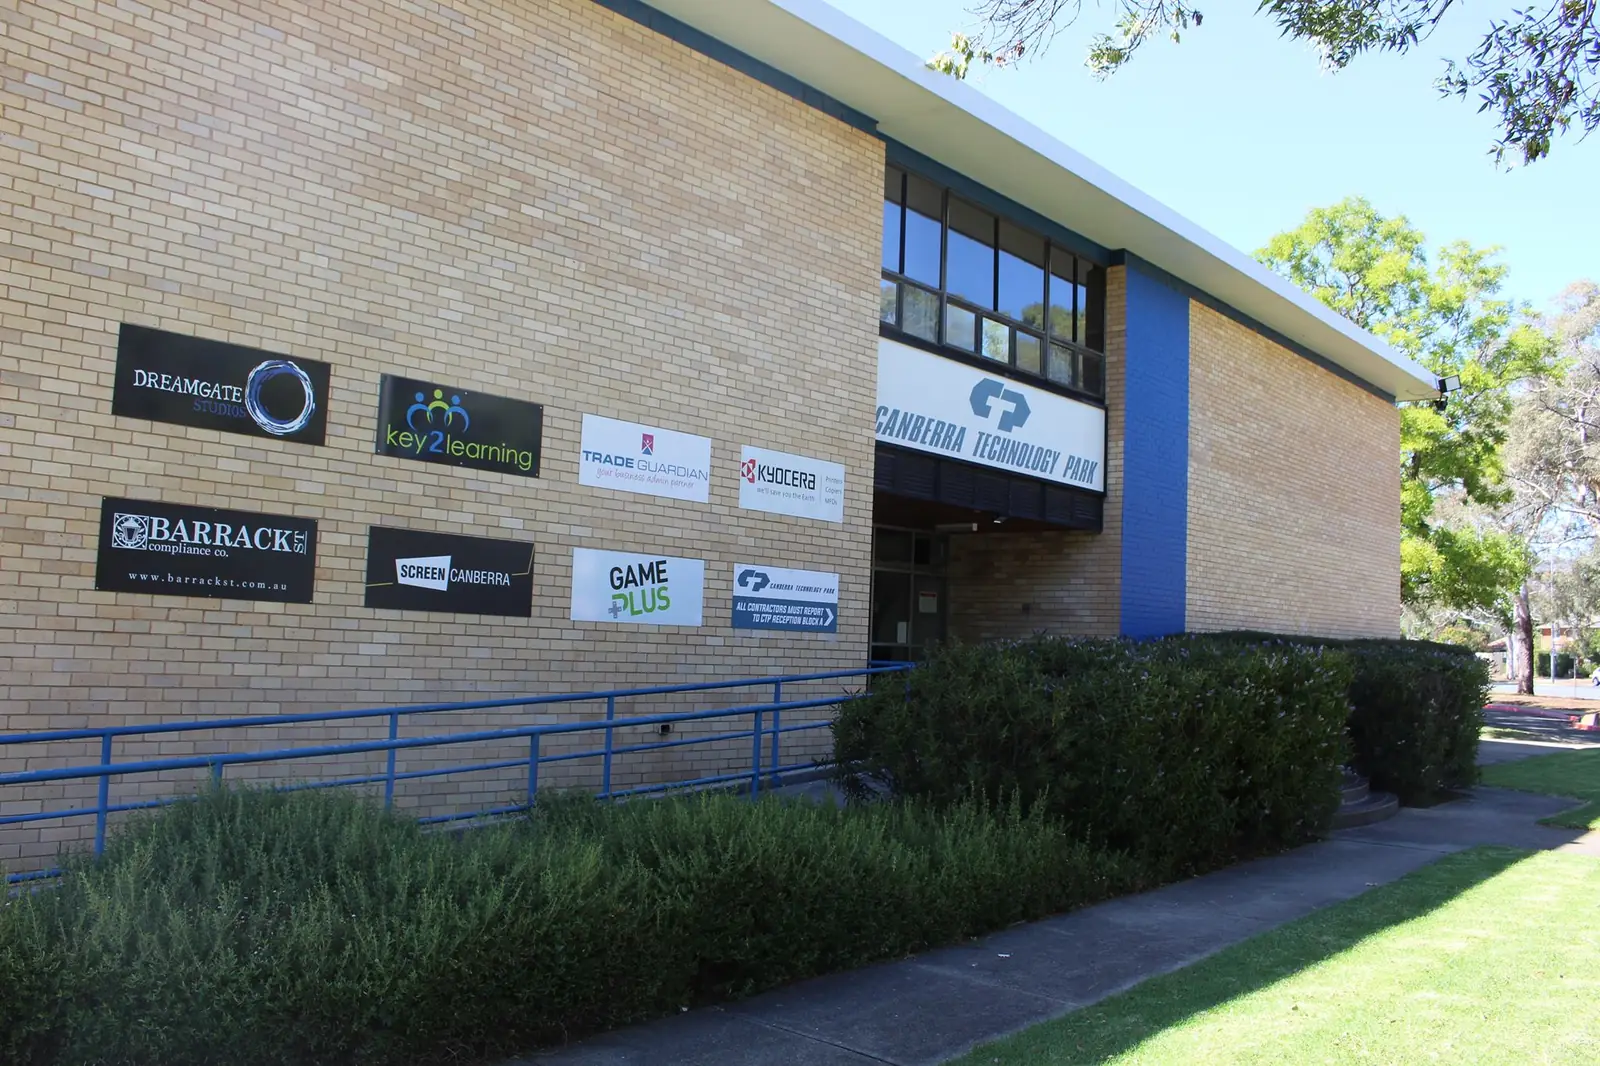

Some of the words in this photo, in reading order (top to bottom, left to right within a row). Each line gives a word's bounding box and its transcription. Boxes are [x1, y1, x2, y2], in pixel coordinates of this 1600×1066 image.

[133, 369, 243, 403] DREAMGATE
[193, 400, 247, 418] STUDIOS
[876, 405, 967, 453] CANBERRA
[972, 431, 1061, 475] TECHNOLOGY
[1062, 454, 1098, 485] PARK
[582, 450, 634, 468] TRADE
[637, 460, 708, 481] GUARDIAN
[148, 516, 293, 552] BARRACK
[148, 543, 211, 556] compliance
[214, 548, 229, 557] co.
[128, 572, 287, 591] www.barrackst.com.au
[400, 564, 446, 581] SCREEN
[450, 568, 511, 586] CANBERRA
[609, 560, 669, 590] GAME
[769, 583, 794, 591] CANBERRA
[795, 585, 822, 594] TECHNOLOGY
[609, 586, 671, 618] PLUS
[736, 602, 746, 611] ALL
[747, 603, 787, 614] CONTRACTORS
[787, 606, 804, 615] MUST
[804, 607, 824, 616] REPORT
[752, 614, 760, 622] TO
[760, 614, 772, 623] CTP
[772, 615, 801, 625] RECEPTION
[802, 617, 819, 625] BLOCK
[818, 618, 823, 626] A
